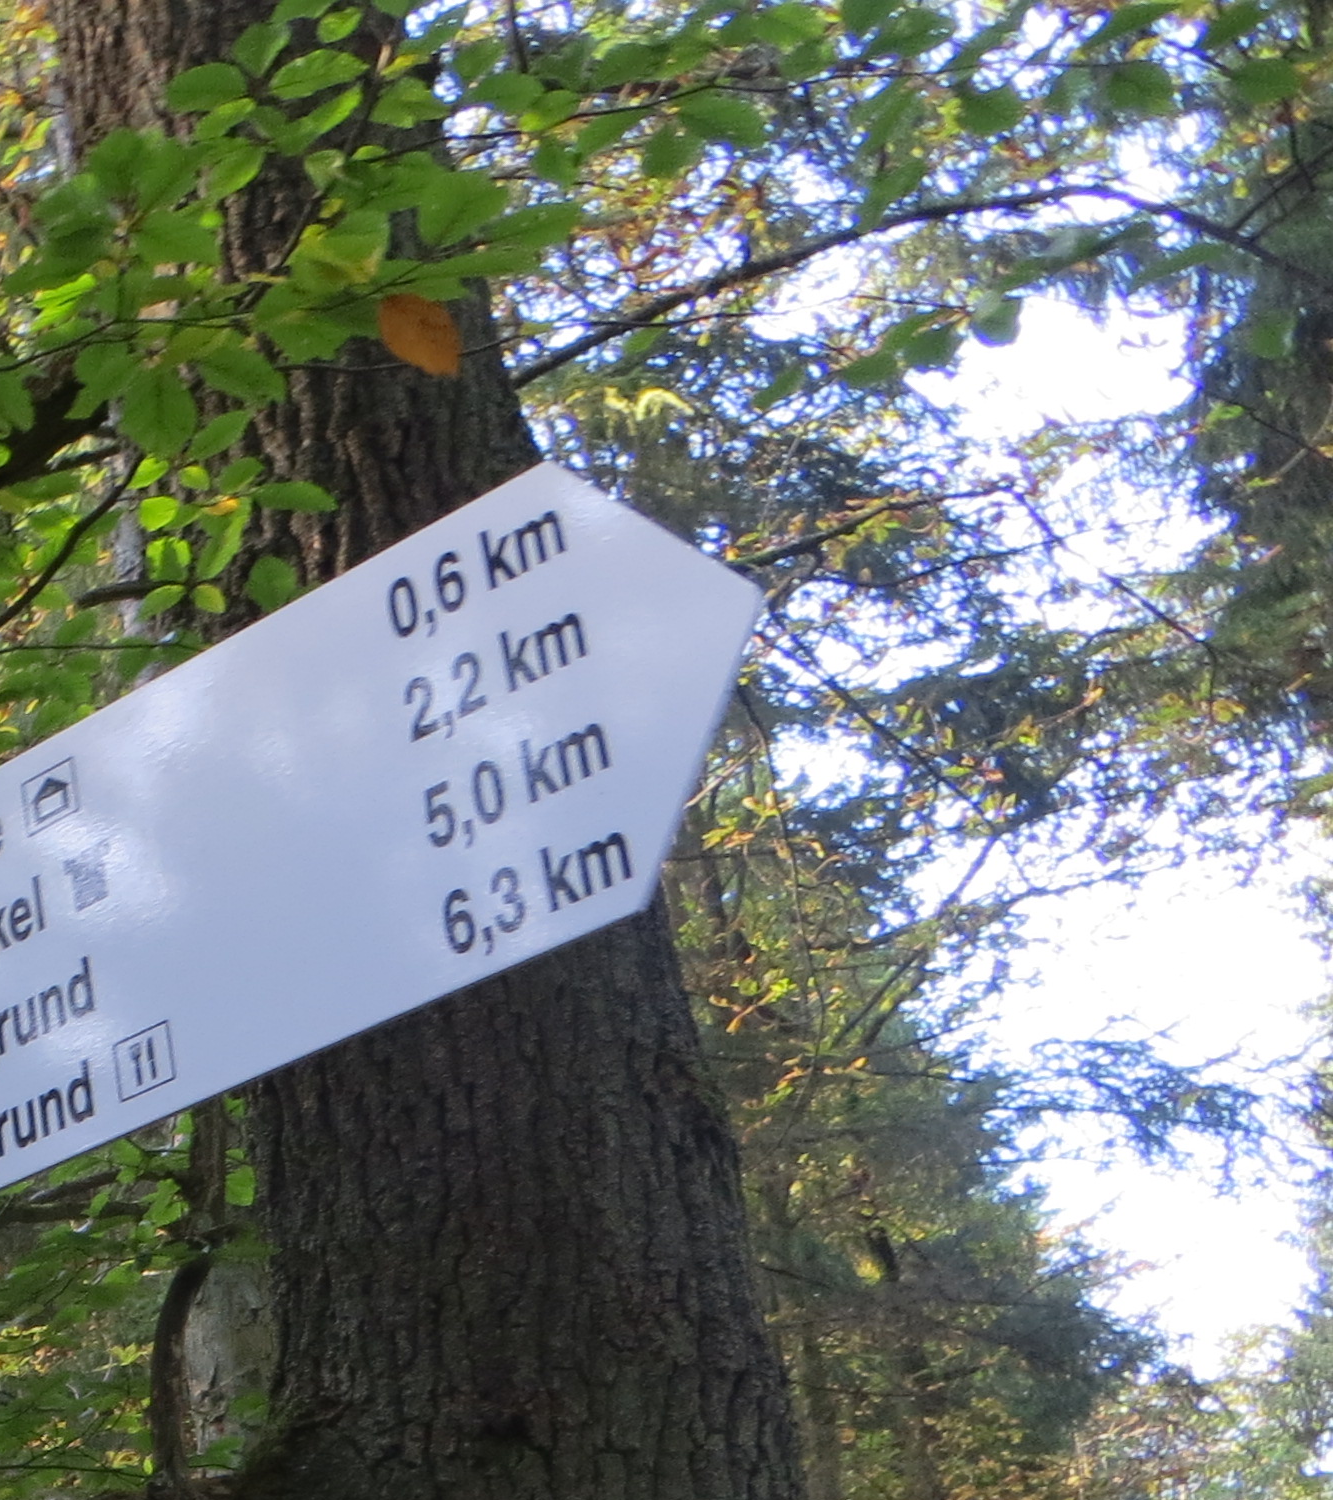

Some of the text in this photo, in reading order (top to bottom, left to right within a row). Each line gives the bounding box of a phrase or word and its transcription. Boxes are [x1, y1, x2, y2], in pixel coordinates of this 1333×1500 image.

[387, 510, 567, 637] 0,6 km
[403, 612, 588, 742] 2,2 km
[423, 723, 612, 849] 5,0 km
[443, 832, 634, 956] 6,3 km
